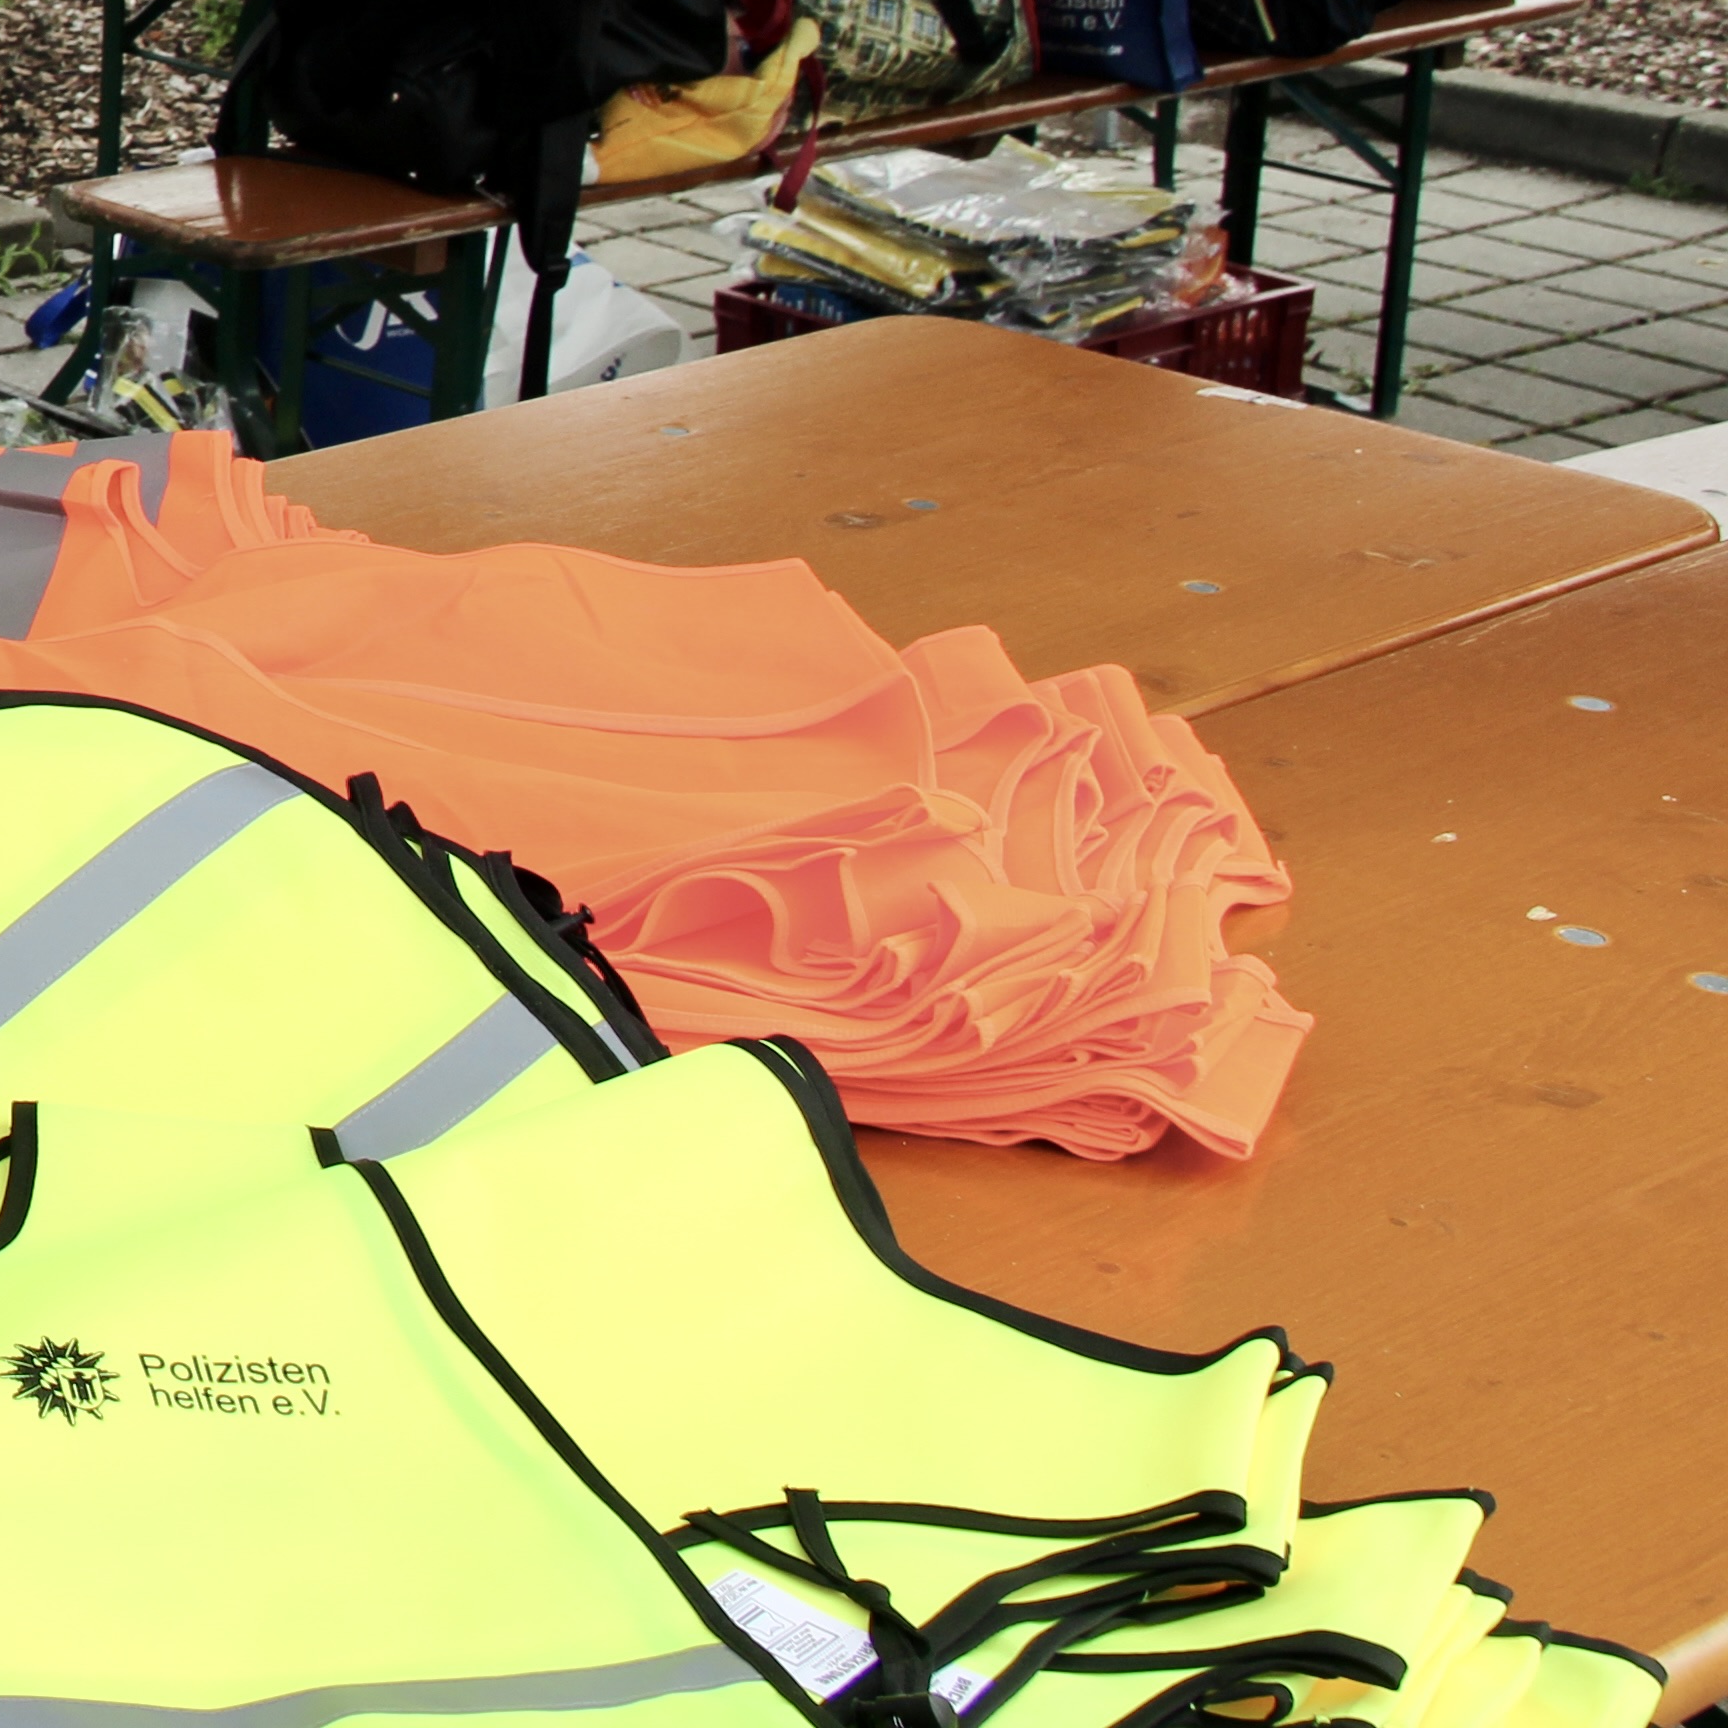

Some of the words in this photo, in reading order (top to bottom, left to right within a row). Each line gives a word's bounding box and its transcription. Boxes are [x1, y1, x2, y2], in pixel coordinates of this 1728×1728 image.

[138, 1352, 331, 1385] Polizisten
[149, 1382, 260, 1415] helfen
[272, 1388, 341, 1416] e.V.
